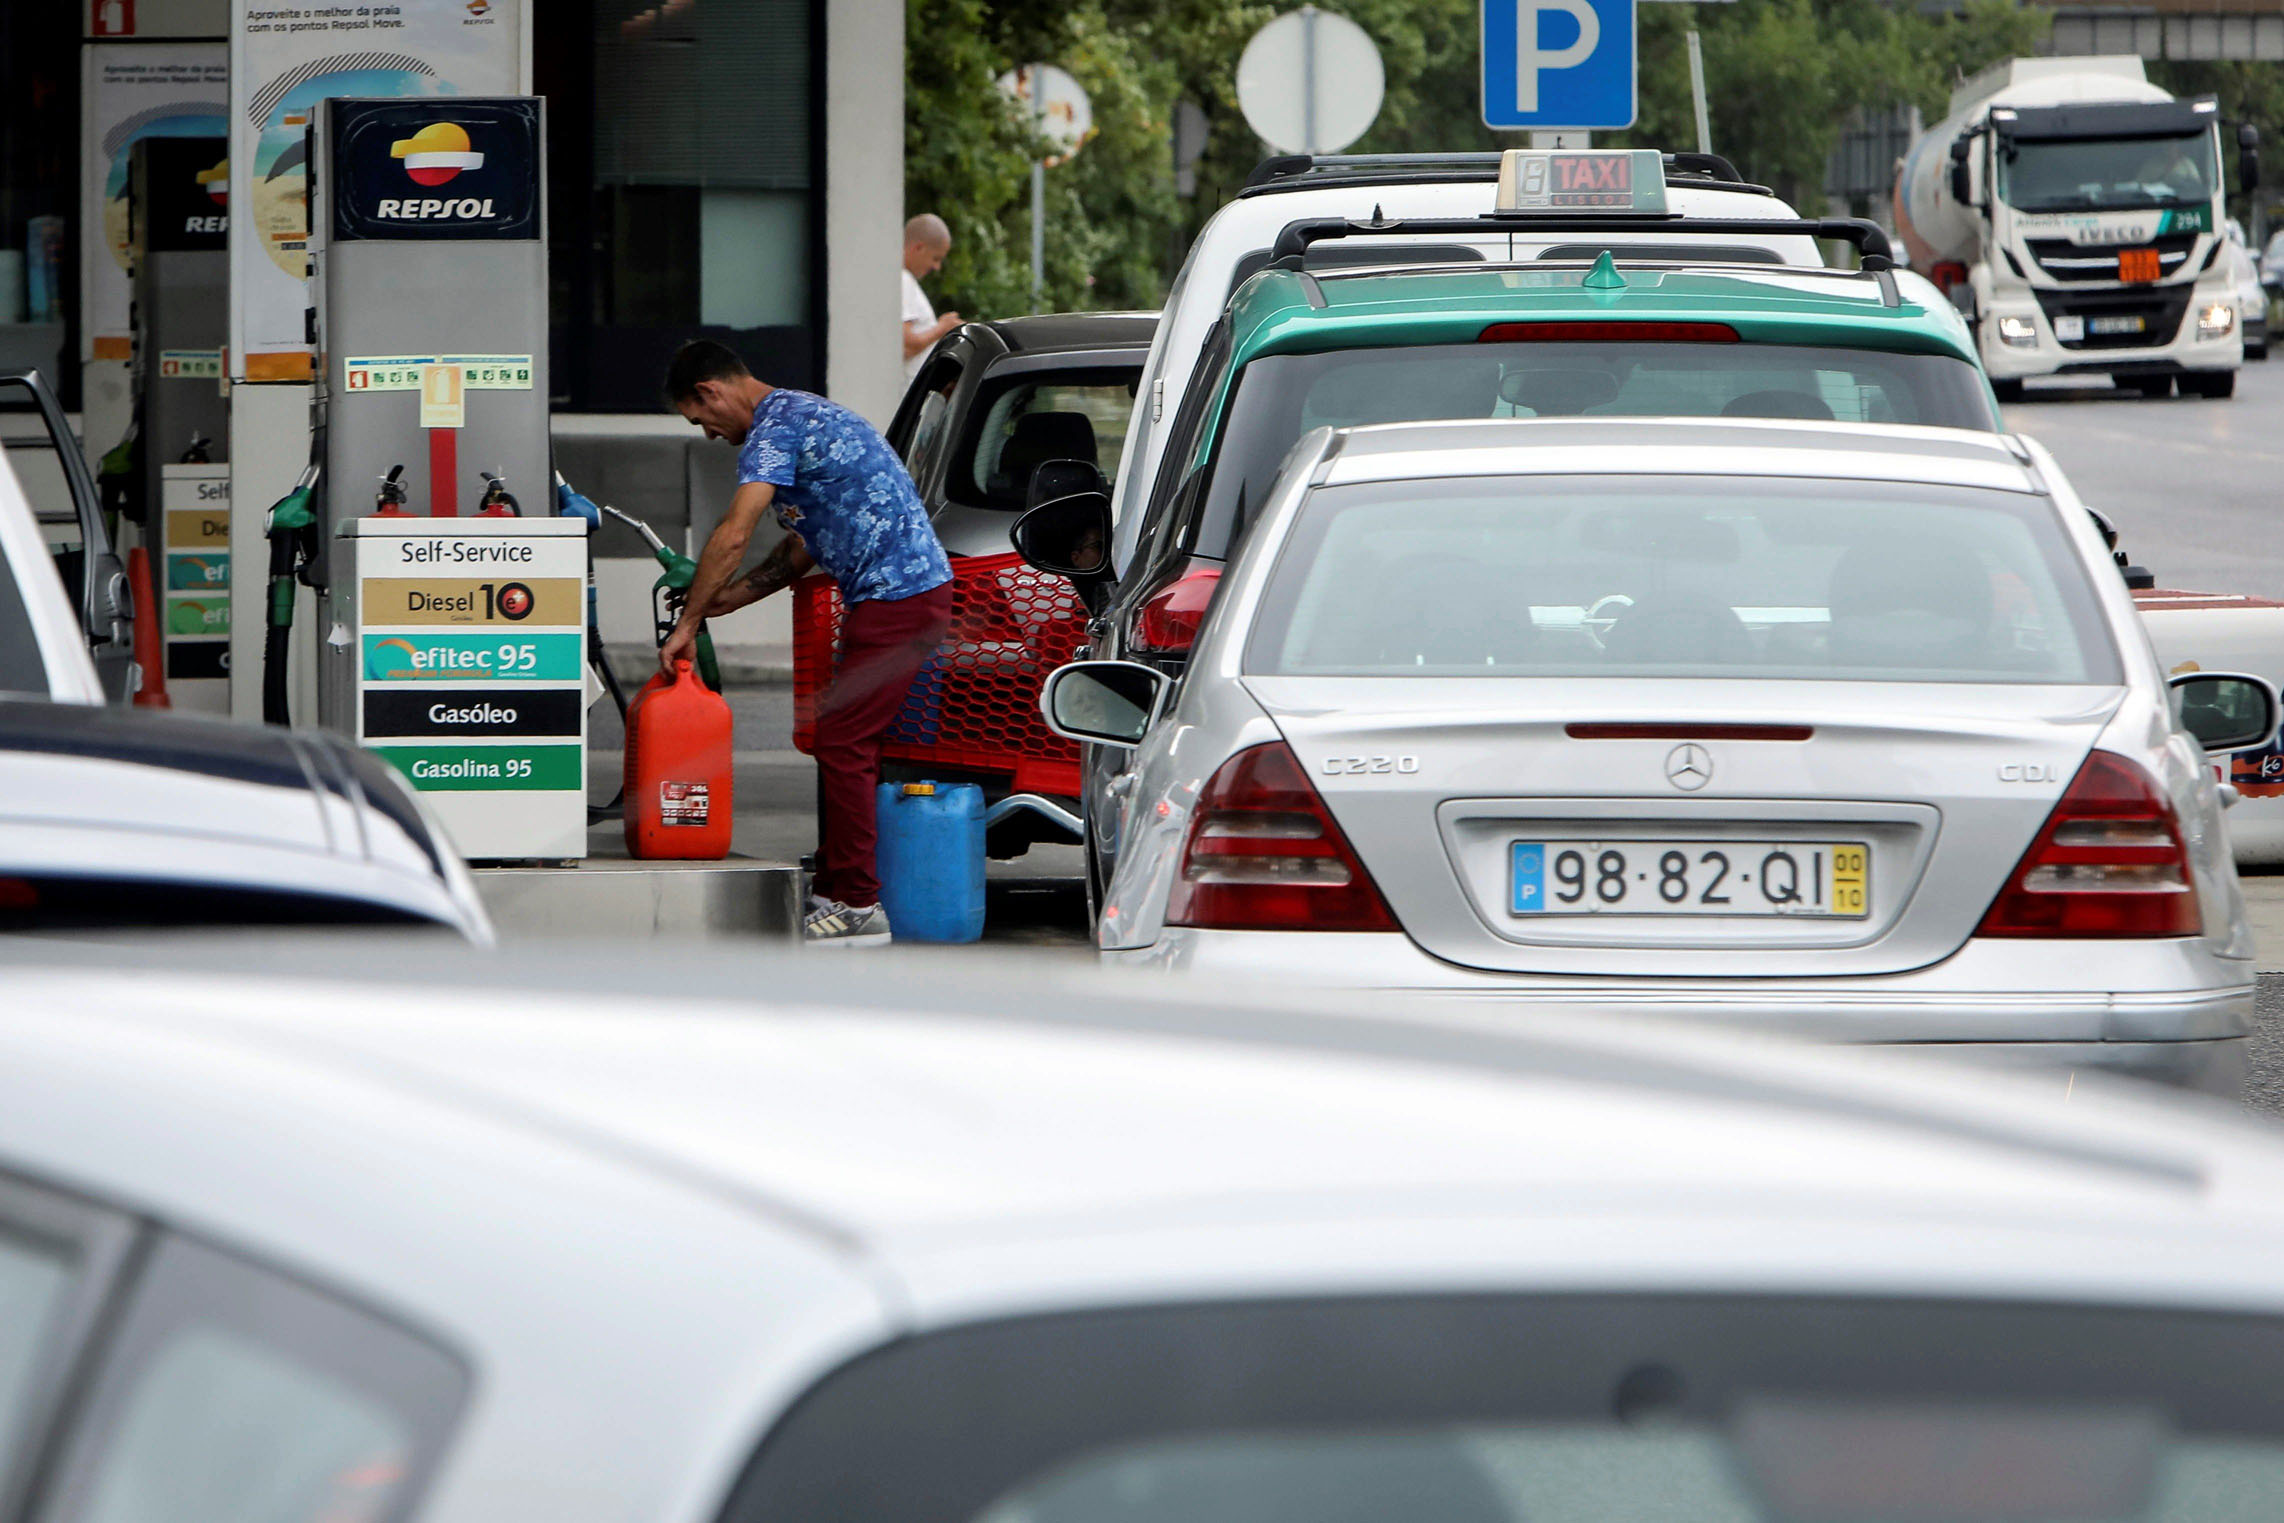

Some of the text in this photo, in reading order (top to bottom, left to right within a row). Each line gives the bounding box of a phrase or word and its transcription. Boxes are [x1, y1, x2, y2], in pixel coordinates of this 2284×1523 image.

[247, 9, 300, 20] Aproveite
[314, 7, 353, 17] melhor
[356, 6, 370, 16] da
[373, 5, 400, 17] praia
[247, 19, 405, 34] com os pontos Repsol Move.
[1516, 0, 1600, 112] P
[1554, 158, 1629, 190] TAXI
[378, 198, 496, 219] REPSOL
[1554, 196, 1629, 205] LISBOA
[2079, 227, 2144, 243] IVECO
[401, 541, 533, 563] Self-Service
[408, 591, 474, 611] Diesel
[411, 644, 537, 670] efitec 95
[428, 703, 517, 724] Gasóleo
[412, 759, 532, 778] Gasolina 95
[1996, 764, 2057, 782] CDI
[1835, 853, 1862, 872] 00
[1522, 885, 1536, 899] P
[1837, 888, 1862, 907] 10
